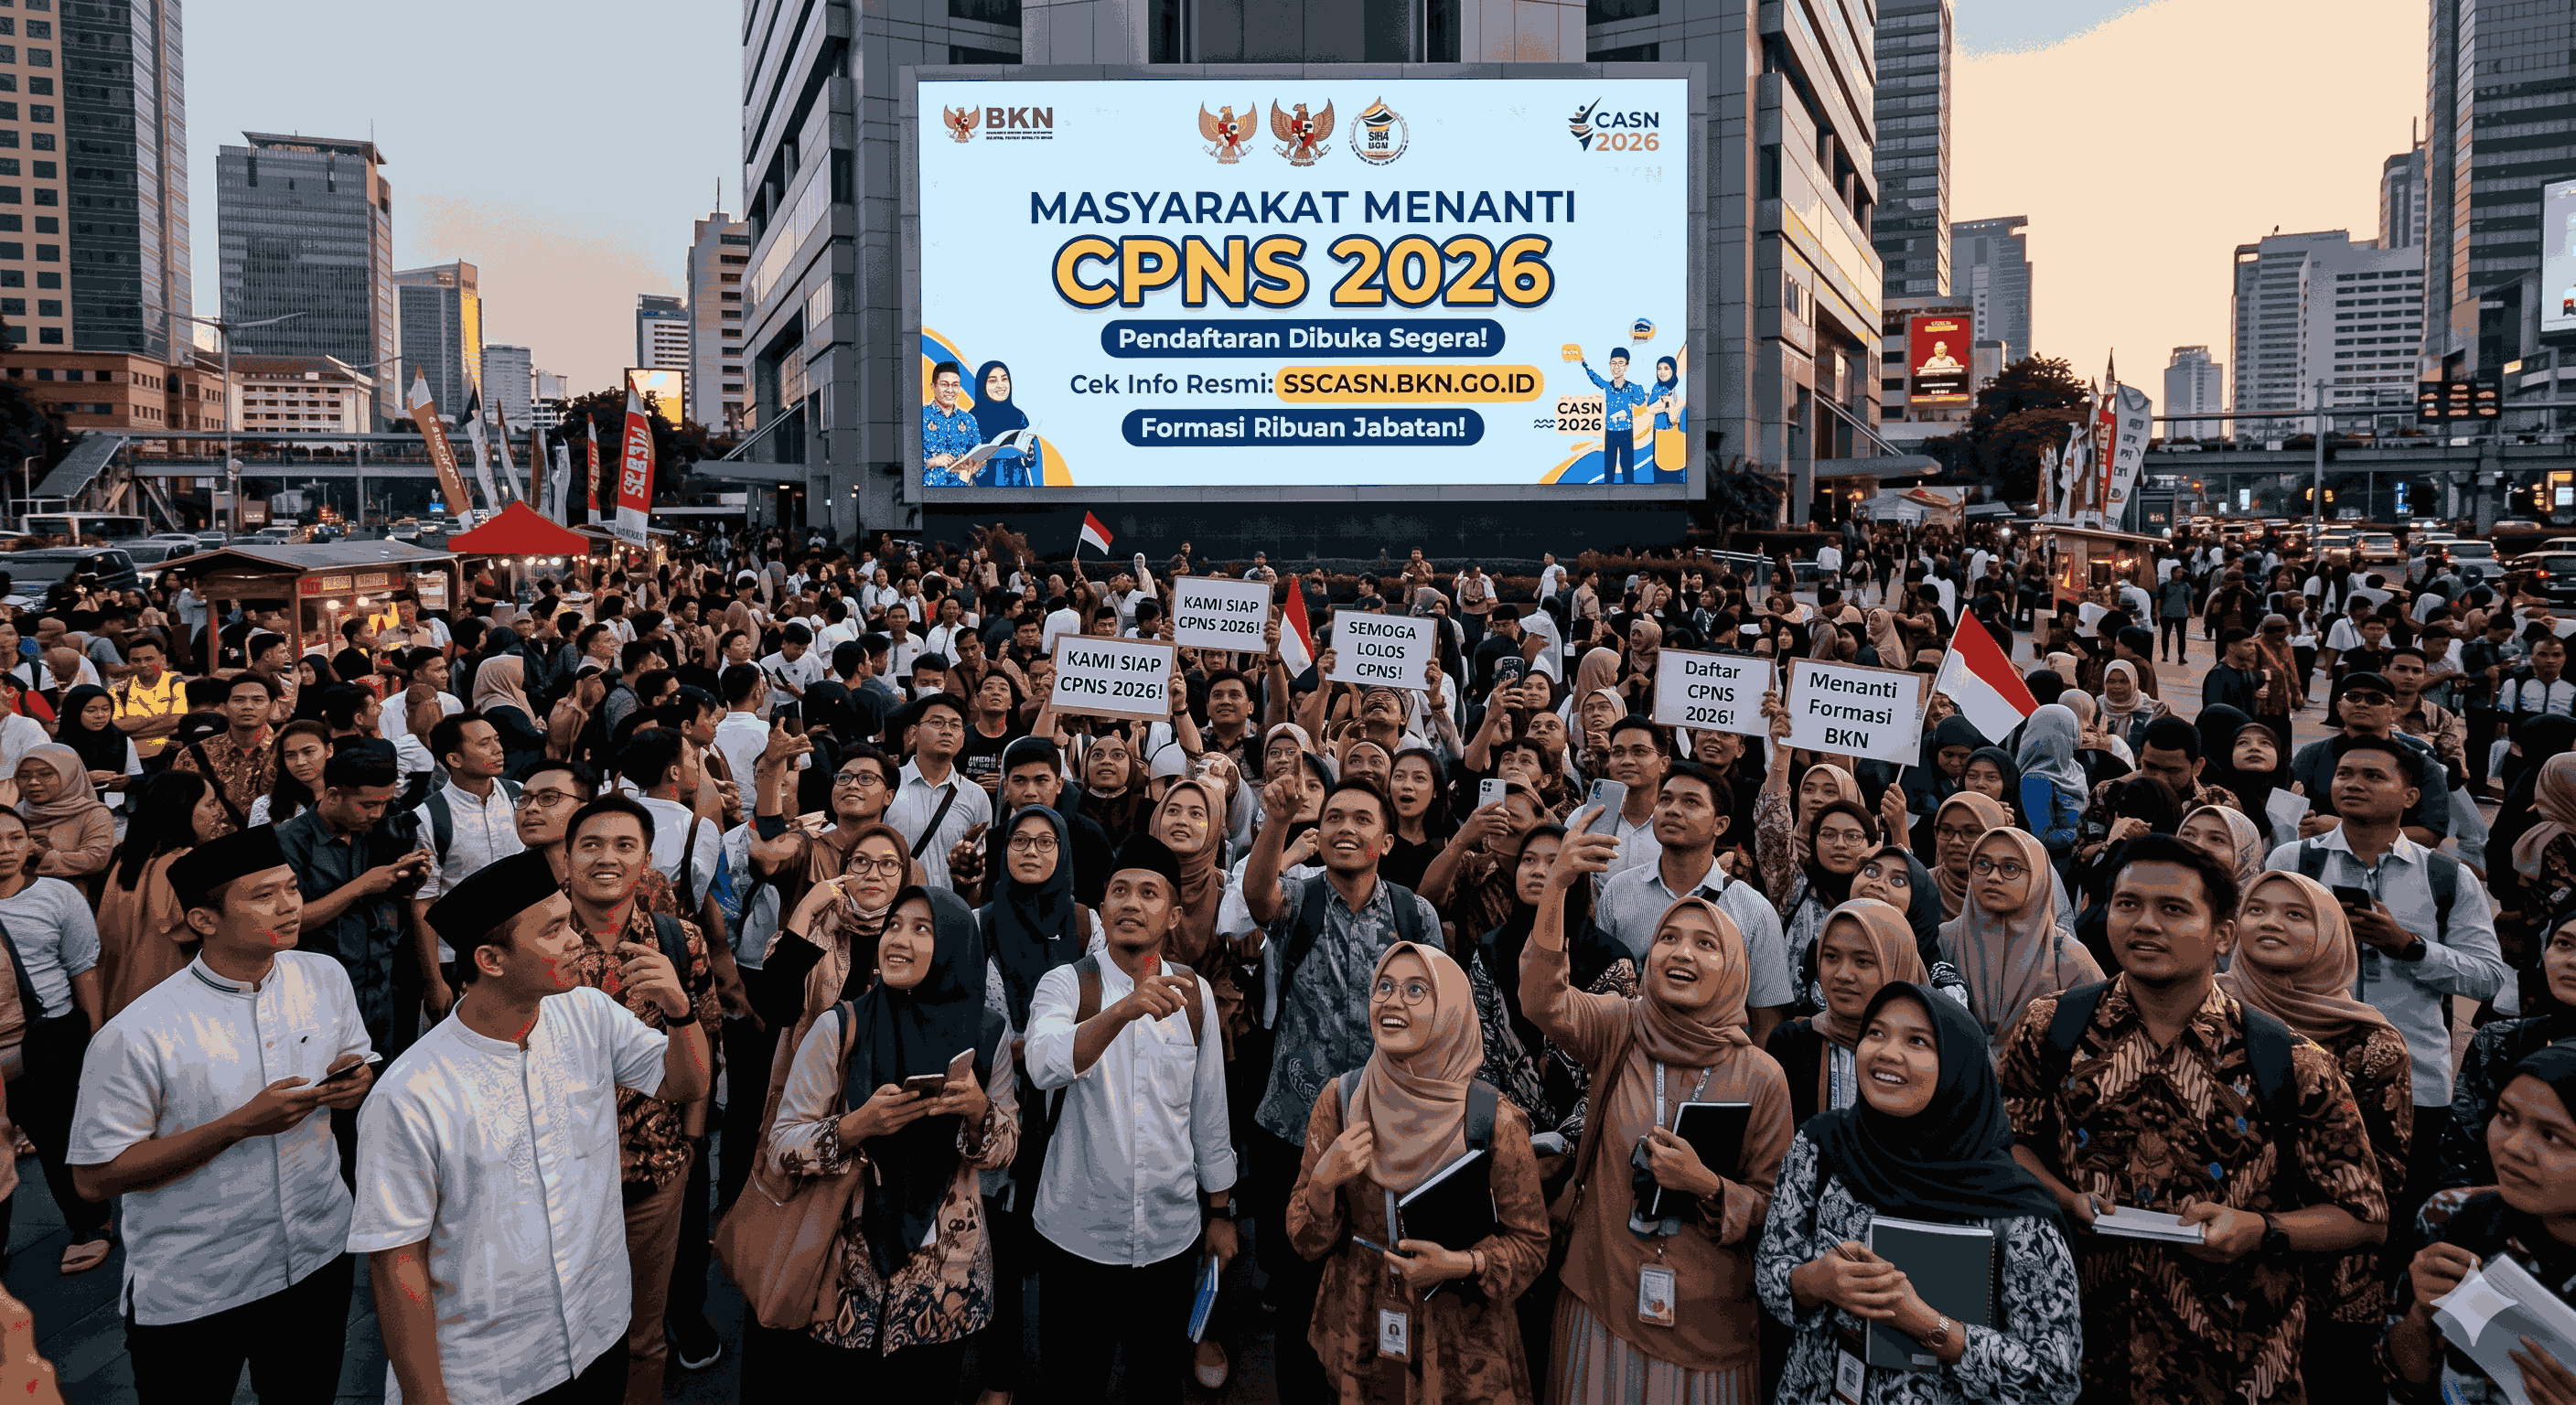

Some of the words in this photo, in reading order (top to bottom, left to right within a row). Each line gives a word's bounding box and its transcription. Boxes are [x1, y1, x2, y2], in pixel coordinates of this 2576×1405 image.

[986, 107, 1053, 129] BKN
[1594, 111, 1659, 129] CASN
[1595, 132, 1660, 152] 2026
[1031, 190, 1349, 224] MASYARAKAT
[1365, 190, 1574, 223] MENANTI
[1052, 233, 1311, 310] CPNS
[1326, 233, 1556, 309] 2026
[1119, 327, 1281, 349] Pendaftaran
[1289, 326, 1382, 349] Dibuka
[1389, 327, 1487, 354] Segera!
[1070, 373, 1121, 394] Cek
[1129, 372, 1178, 394] Info
[1186, 372, 1273, 394] Resmi:
[1283, 373, 1535, 394] SSCASN.BKN.GO.ID
[1557, 402, 1603, 414] CASN
[1142, 415, 1245, 438] Formasi
[1254, 415, 1347, 438] Ribuan
[1352, 415, 1466, 437] Jabatan!
[1558, 418, 1602, 431] 2026
[1184, 595, 1222, 611] KAMI
[1226, 599, 1259, 614] SIAP
[1178, 616, 1217, 631] CPNS
[1219, 618, 1260, 635] 2026!
[1348, 621, 1417, 640] SEMOGA
[1357, 642, 1405, 660] LOLOS
[1068, 650, 1115, 670] KAMI
[1120, 655, 1162, 673] SIAP
[1356, 662, 1402, 680] CPNS!
[1685, 660, 1742, 680] Daftar
[1060, 676, 1108, 695] CPNS
[1111, 681, 1164, 700] 2026!
[1687, 684, 1734, 702] CPNS
[1809, 671, 1898, 699] Menanti
[1685, 705, 1734, 725] 2026!
[1809, 698, 1894, 725] Formasi
[1824, 727, 1869, 749] BKN
